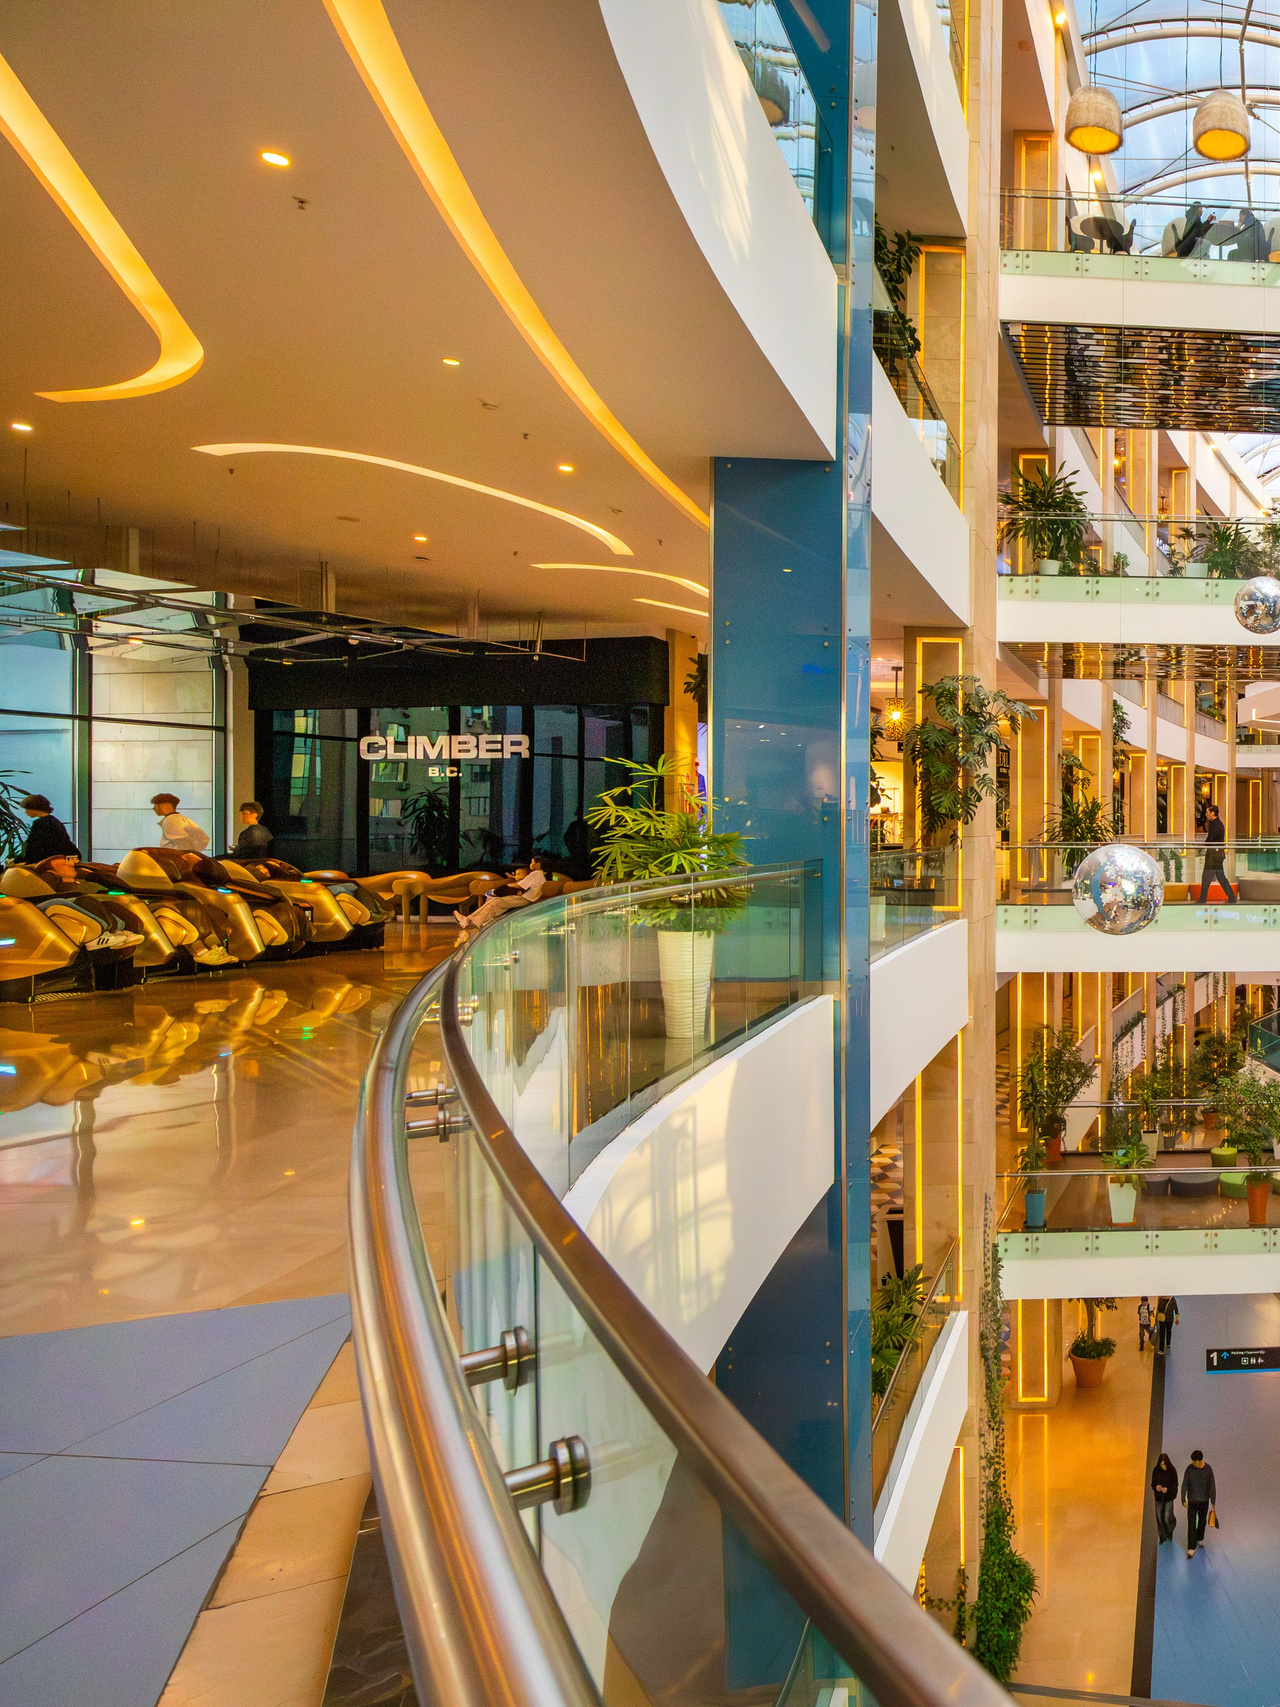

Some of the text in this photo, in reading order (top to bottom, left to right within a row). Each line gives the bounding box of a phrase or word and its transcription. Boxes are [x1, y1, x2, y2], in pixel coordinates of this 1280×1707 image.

[359, 734, 531, 761] CLIMBER
[428, 766, 463, 777] B.C.
[1210, 1351, 1218, 1366] 1
